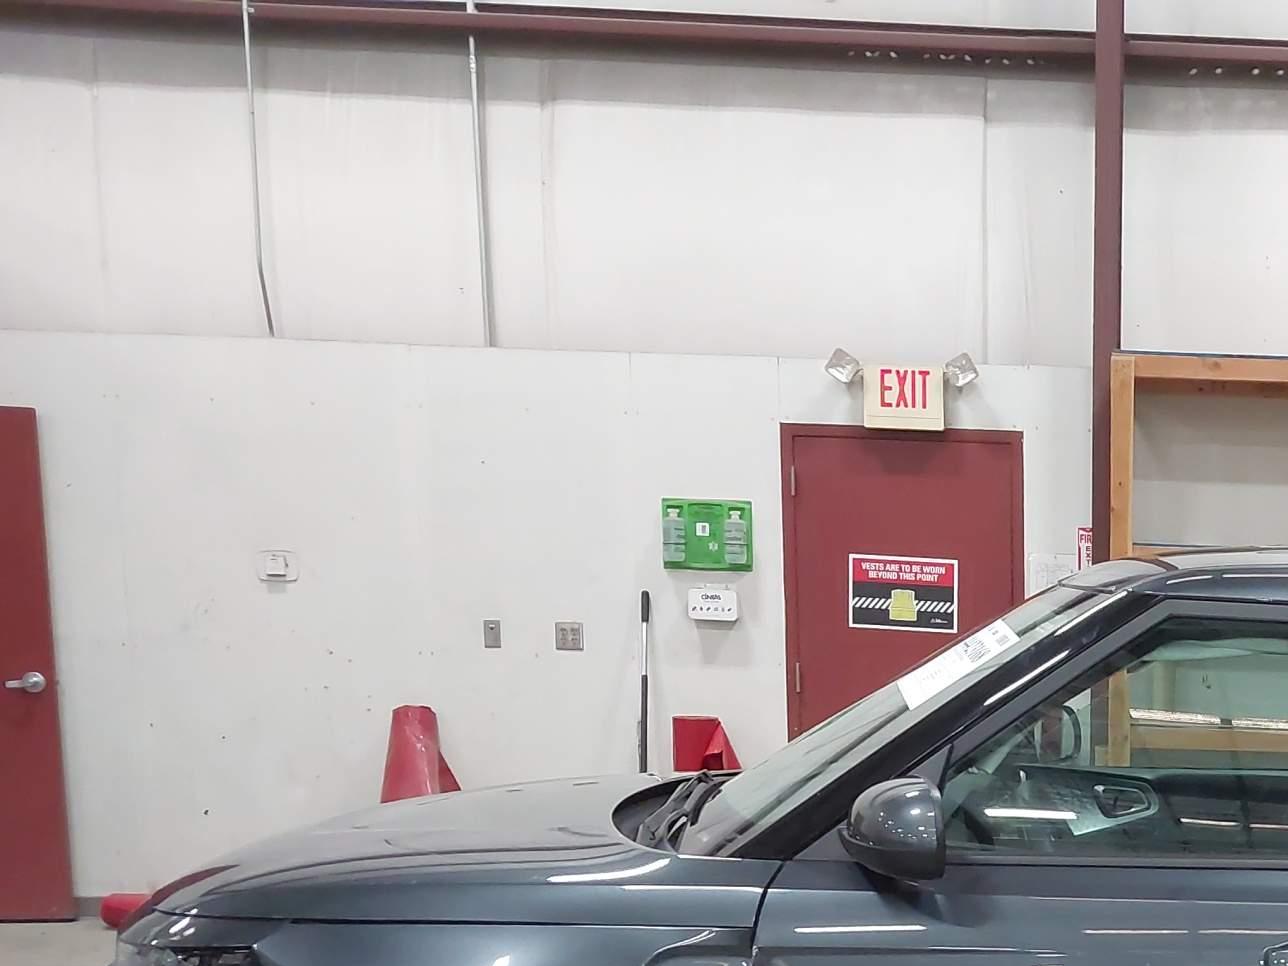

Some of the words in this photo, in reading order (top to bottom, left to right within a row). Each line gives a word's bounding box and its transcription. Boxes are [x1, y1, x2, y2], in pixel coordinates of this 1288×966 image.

[880, 368, 930, 409] EXIT
[1080, 533, 1092, 544] FIR
[861, 562, 884, 570] VESTS
[923, 566, 946, 574] WORN
[869, 570, 897, 579] BEYOND
[916, 574, 939, 582] POINT
